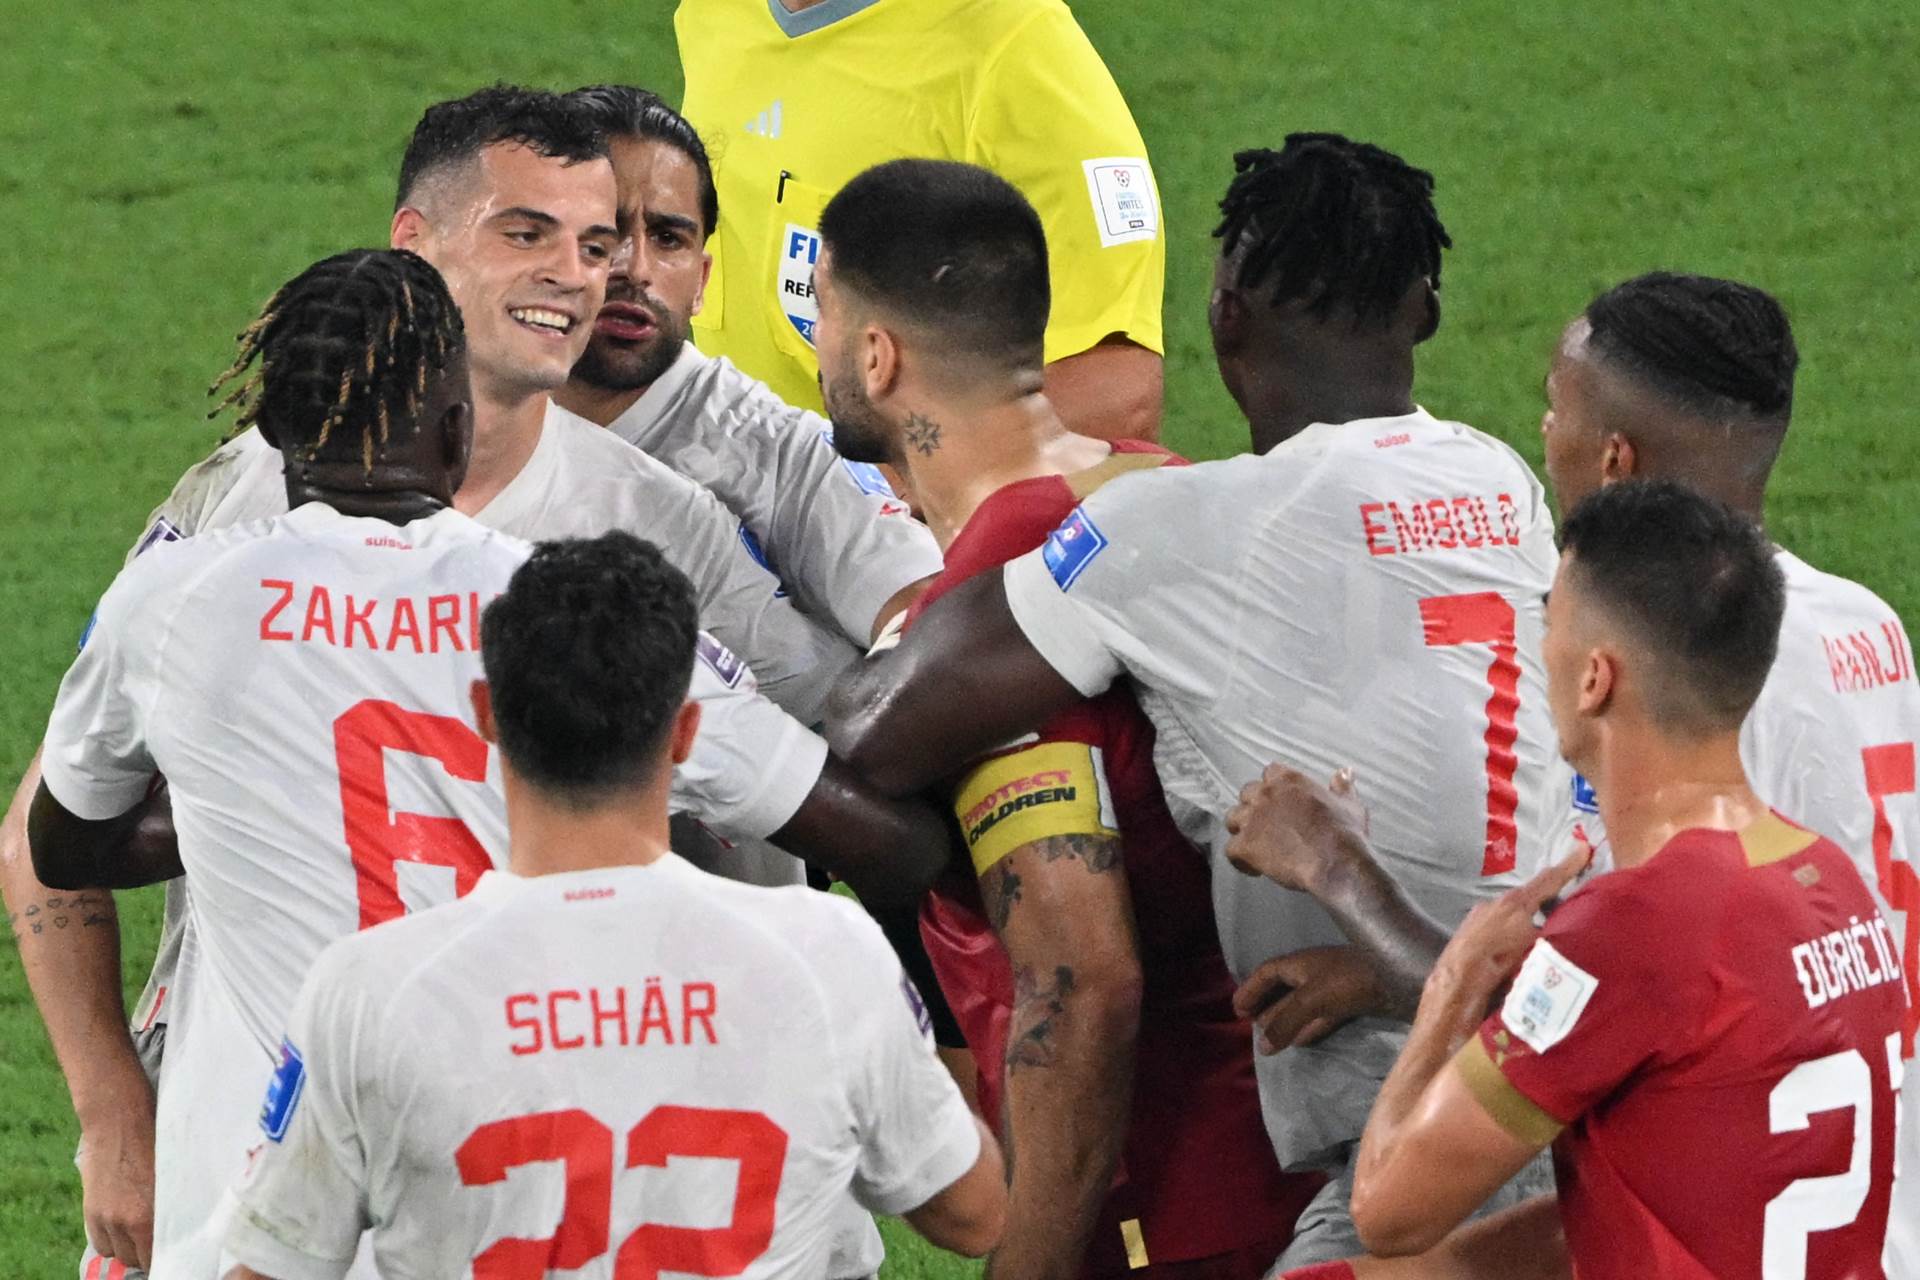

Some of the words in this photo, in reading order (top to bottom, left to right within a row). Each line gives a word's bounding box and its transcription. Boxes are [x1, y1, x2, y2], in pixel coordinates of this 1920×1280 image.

[789, 231, 818, 265] FI
[784, 279, 815, 298] REF
[1360, 493, 1520, 556] EMBOLO
[259, 578, 482, 654] ZAKARI
[1417, 591, 1522, 877] 7
[333, 698, 496, 932] 6
[964, 769, 1072, 831] PROTECT
[968, 786, 1077, 847] CHILDREN
[504, 976, 719, 1056] SCHÄR
[454, 1104, 789, 1280] 22
